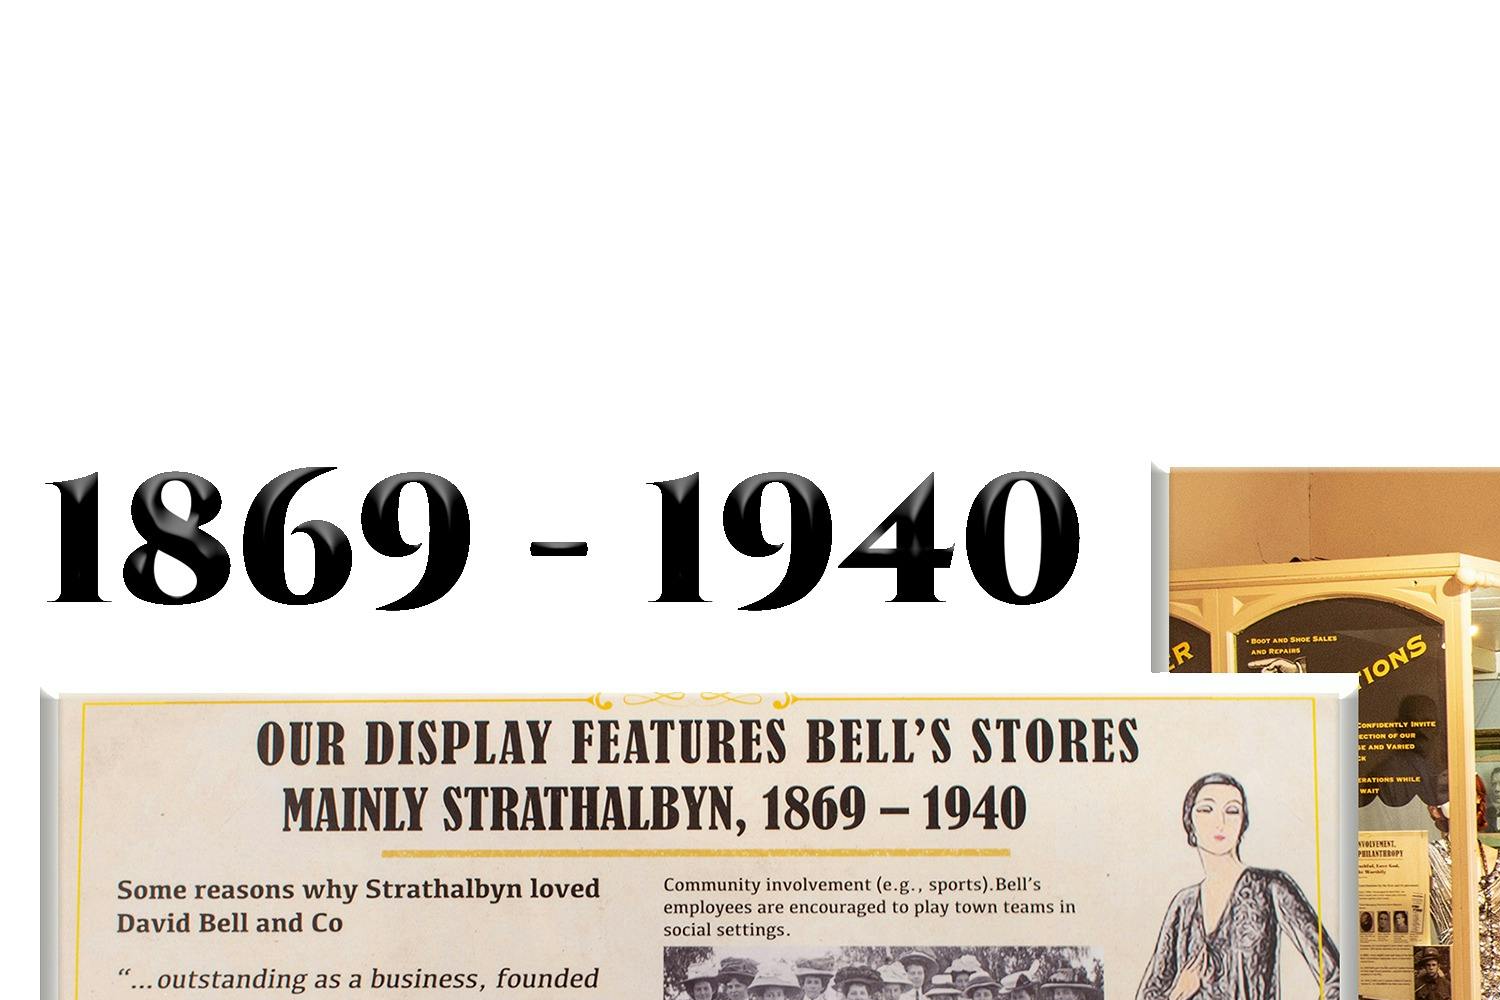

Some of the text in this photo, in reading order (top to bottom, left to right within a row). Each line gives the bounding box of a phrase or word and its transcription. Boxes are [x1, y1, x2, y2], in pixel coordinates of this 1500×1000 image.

[257, 718, 1138, 766] OUR DISPLAY FEATURES BELL'S STORES
[283, 787, 428, 831] MAINLY
[443, 786, 746, 837] STRATHALBYN,
[763, 786, 865, 830] 1869
[923, 785, 1026, 830] 1940
[118, 878, 600, 904] Some reasons why Strathalbyn loved
[664, 878, 760, 895] Community
[767, 877, 871, 891] involvement
[877, 876, 922, 895] (e.g.,
[117, 912, 342, 933] David Bell and Co
[315, 974, 341, 988] as
[349, 974, 361, 988] a
[371, 968, 485, 992] business,
[496, 968, 599, 988] founded
